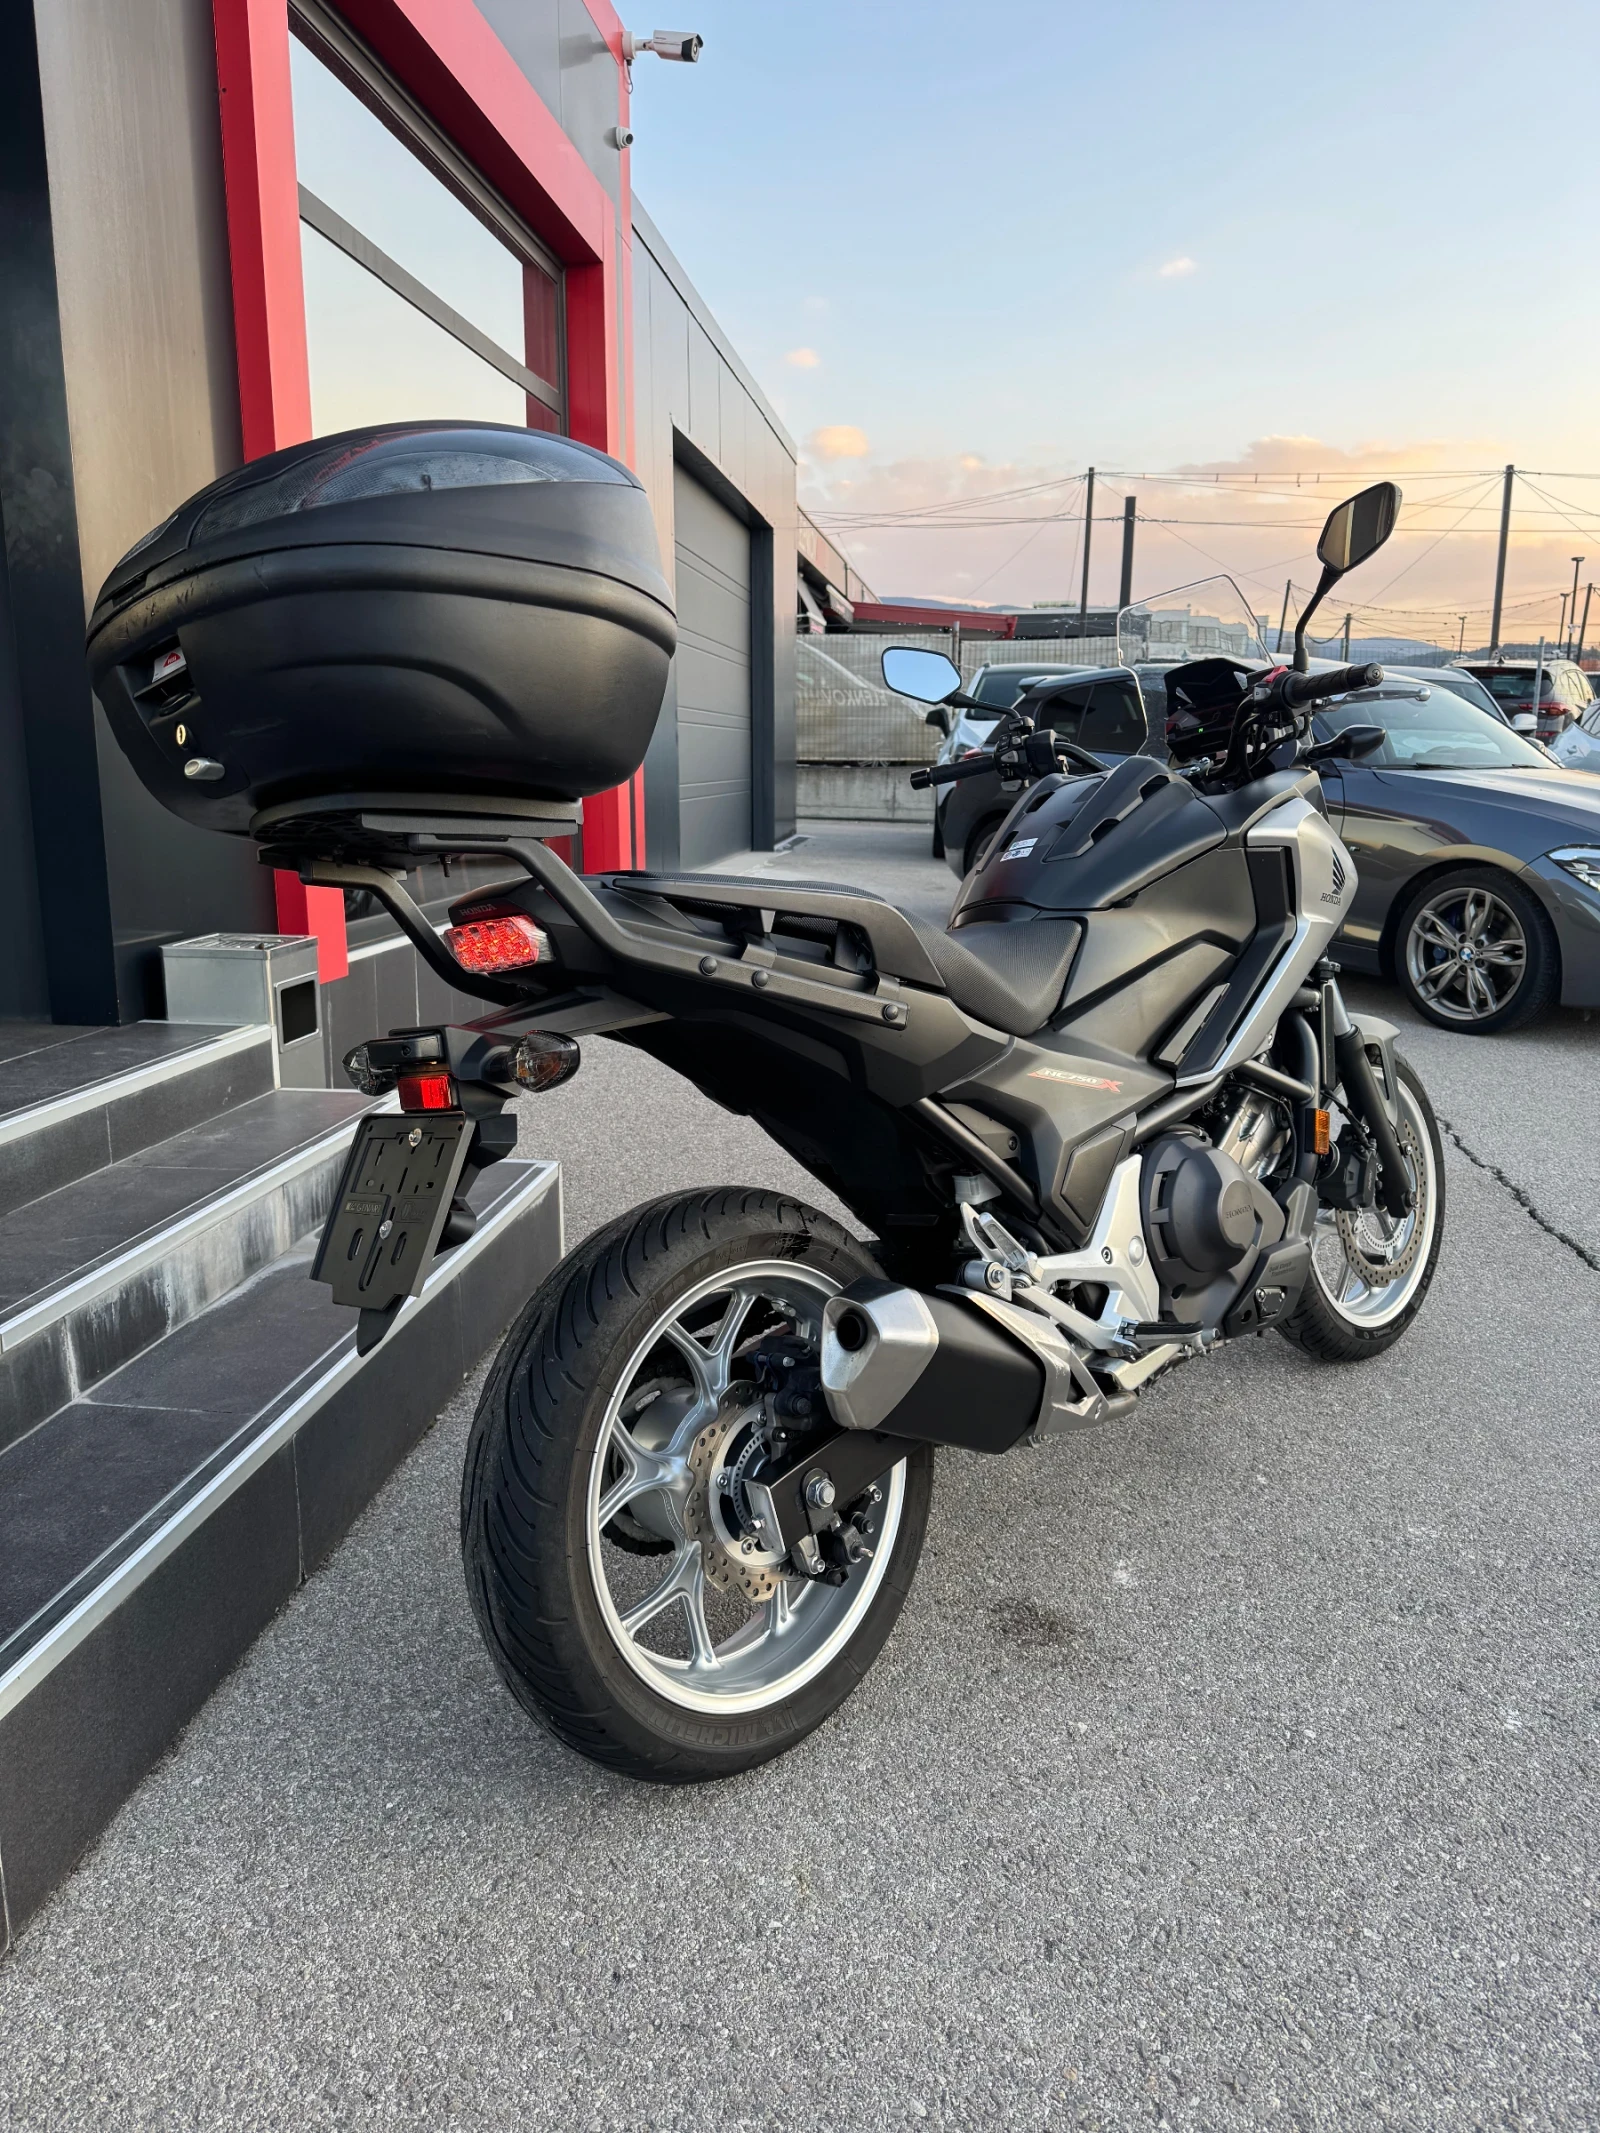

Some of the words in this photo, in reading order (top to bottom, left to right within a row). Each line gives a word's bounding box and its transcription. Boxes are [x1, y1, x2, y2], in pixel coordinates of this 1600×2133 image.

[1320, 892, 1341, 906] HONDA
[459, 903, 498, 916] HONDA
[1225, 1204, 1253, 1219] HONDA
[648, 1708, 758, 1746] MICHELIN
